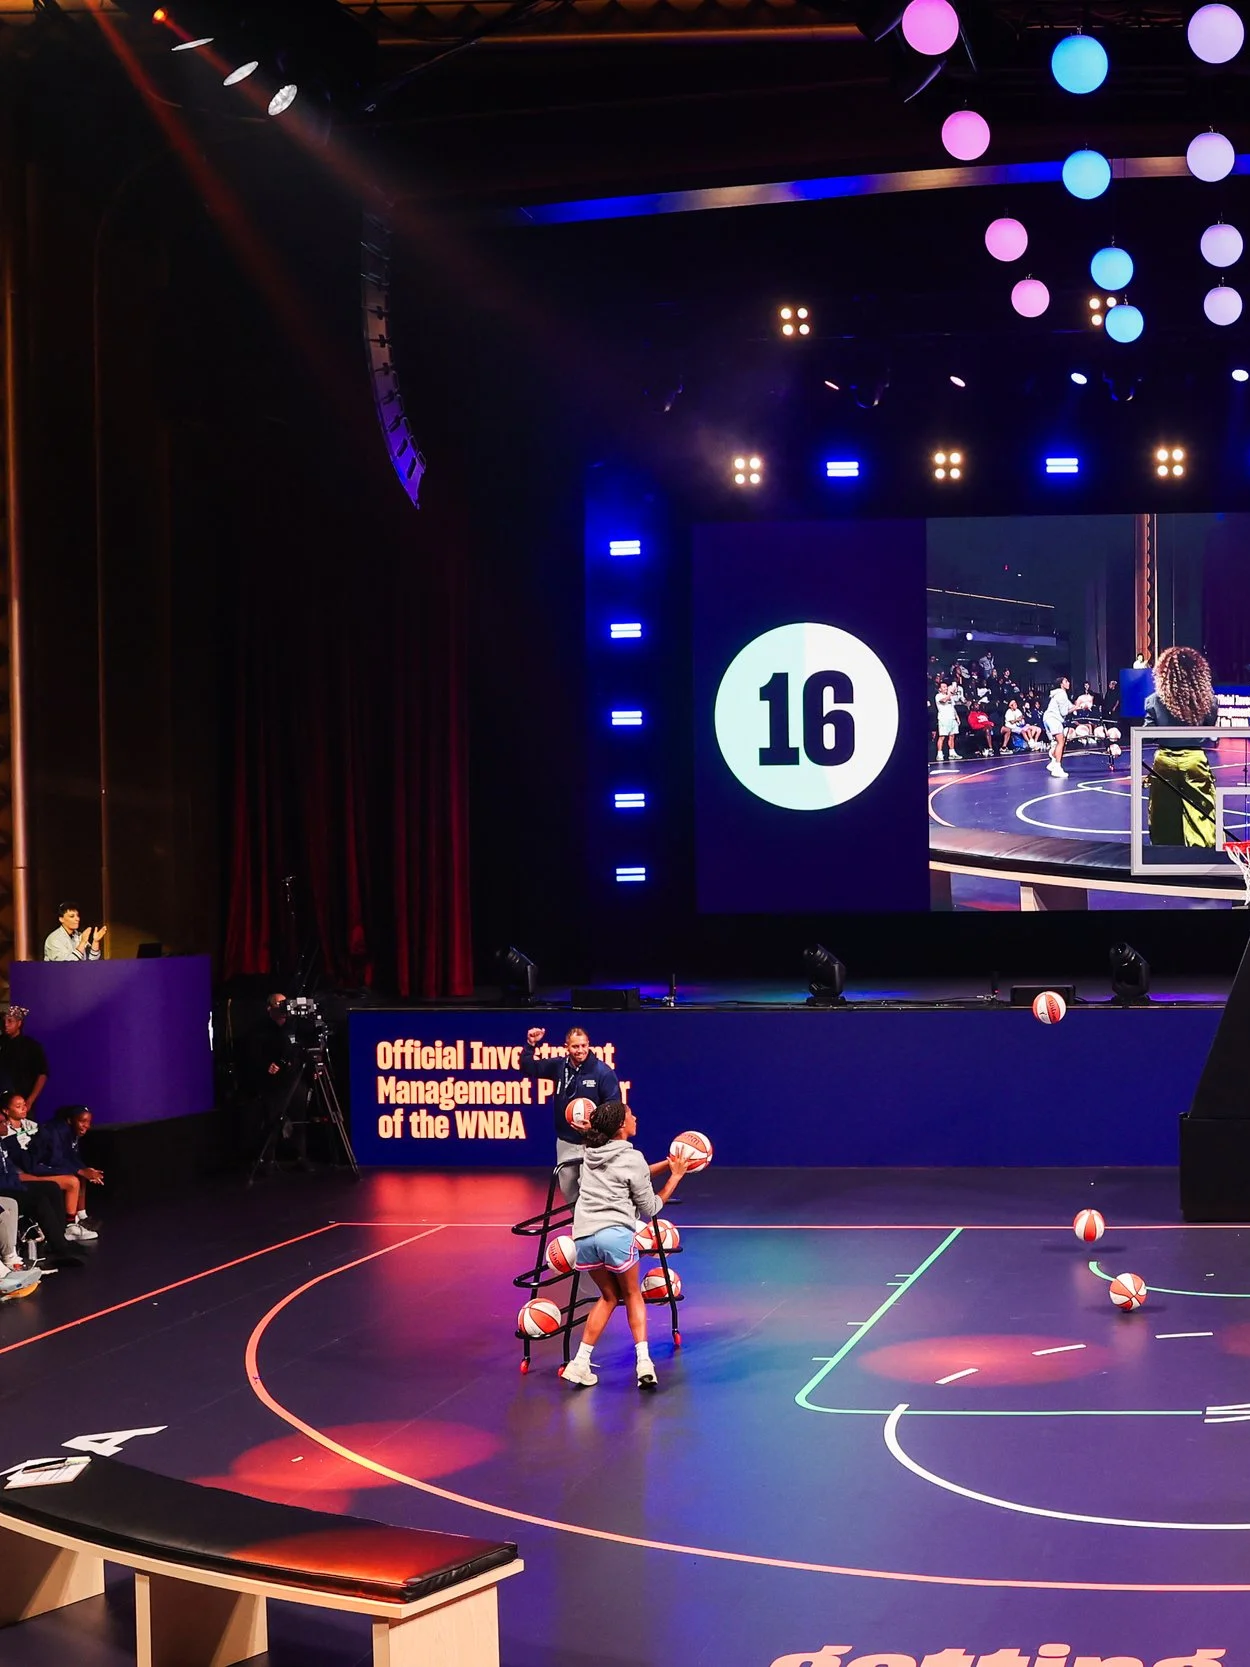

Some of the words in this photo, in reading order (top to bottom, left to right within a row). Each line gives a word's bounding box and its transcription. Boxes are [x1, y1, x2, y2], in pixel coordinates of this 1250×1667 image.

[759, 670, 855, 766] 16
[377, 1039, 465, 1070] Official
[470, 1041, 616, 1070] Invetmnt
[377, 1076, 532, 1111] Management
[378, 1108, 404, 1139] of
[409, 1109, 450, 1139] the
[455, 1110, 527, 1139] WNBA
